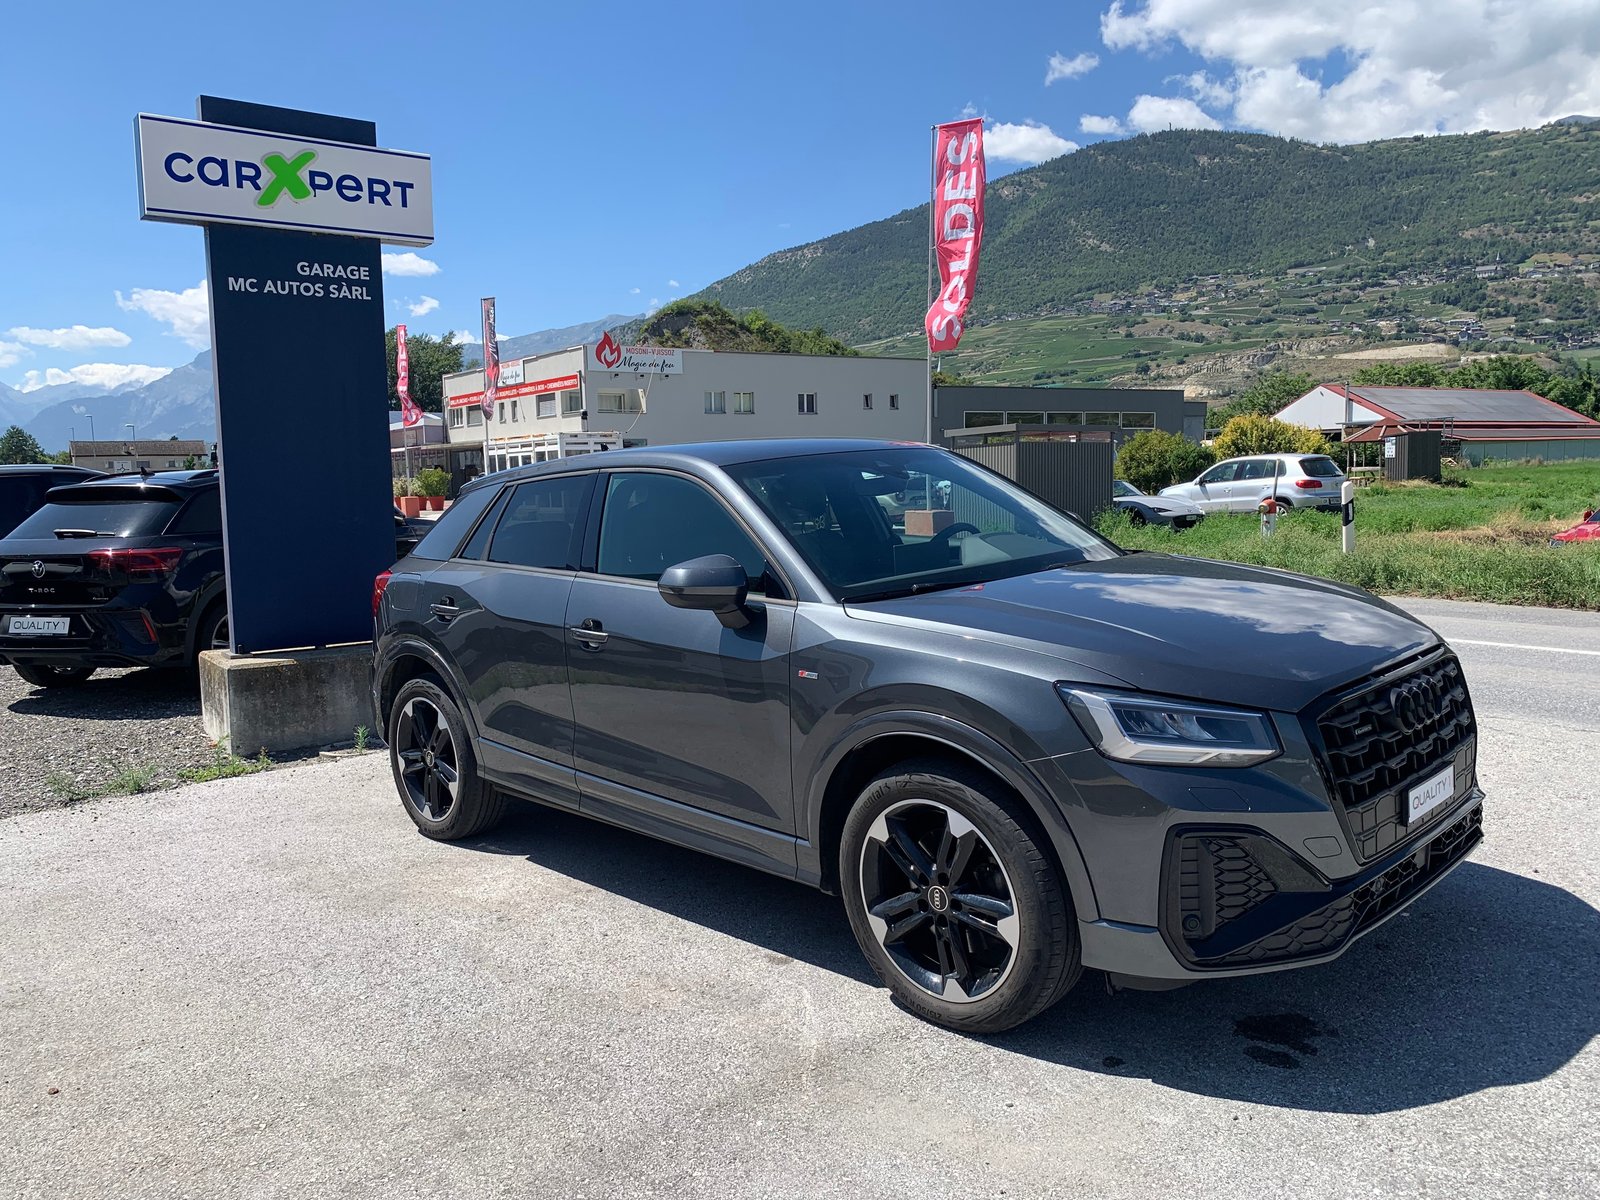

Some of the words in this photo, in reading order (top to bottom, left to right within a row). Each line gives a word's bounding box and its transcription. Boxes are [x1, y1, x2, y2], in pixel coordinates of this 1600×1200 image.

[932, 131, 978, 341] SOLDES
[297, 261, 370, 281] GARAGE
[228, 277, 257, 293] MC
[264, 280, 324, 298] AUTOS
[616, 355, 647, 372] Magie
[648, 359, 659, 368] du
[660, 359, 675, 373] feu
[1412, 777, 1448, 810] QUALITY
